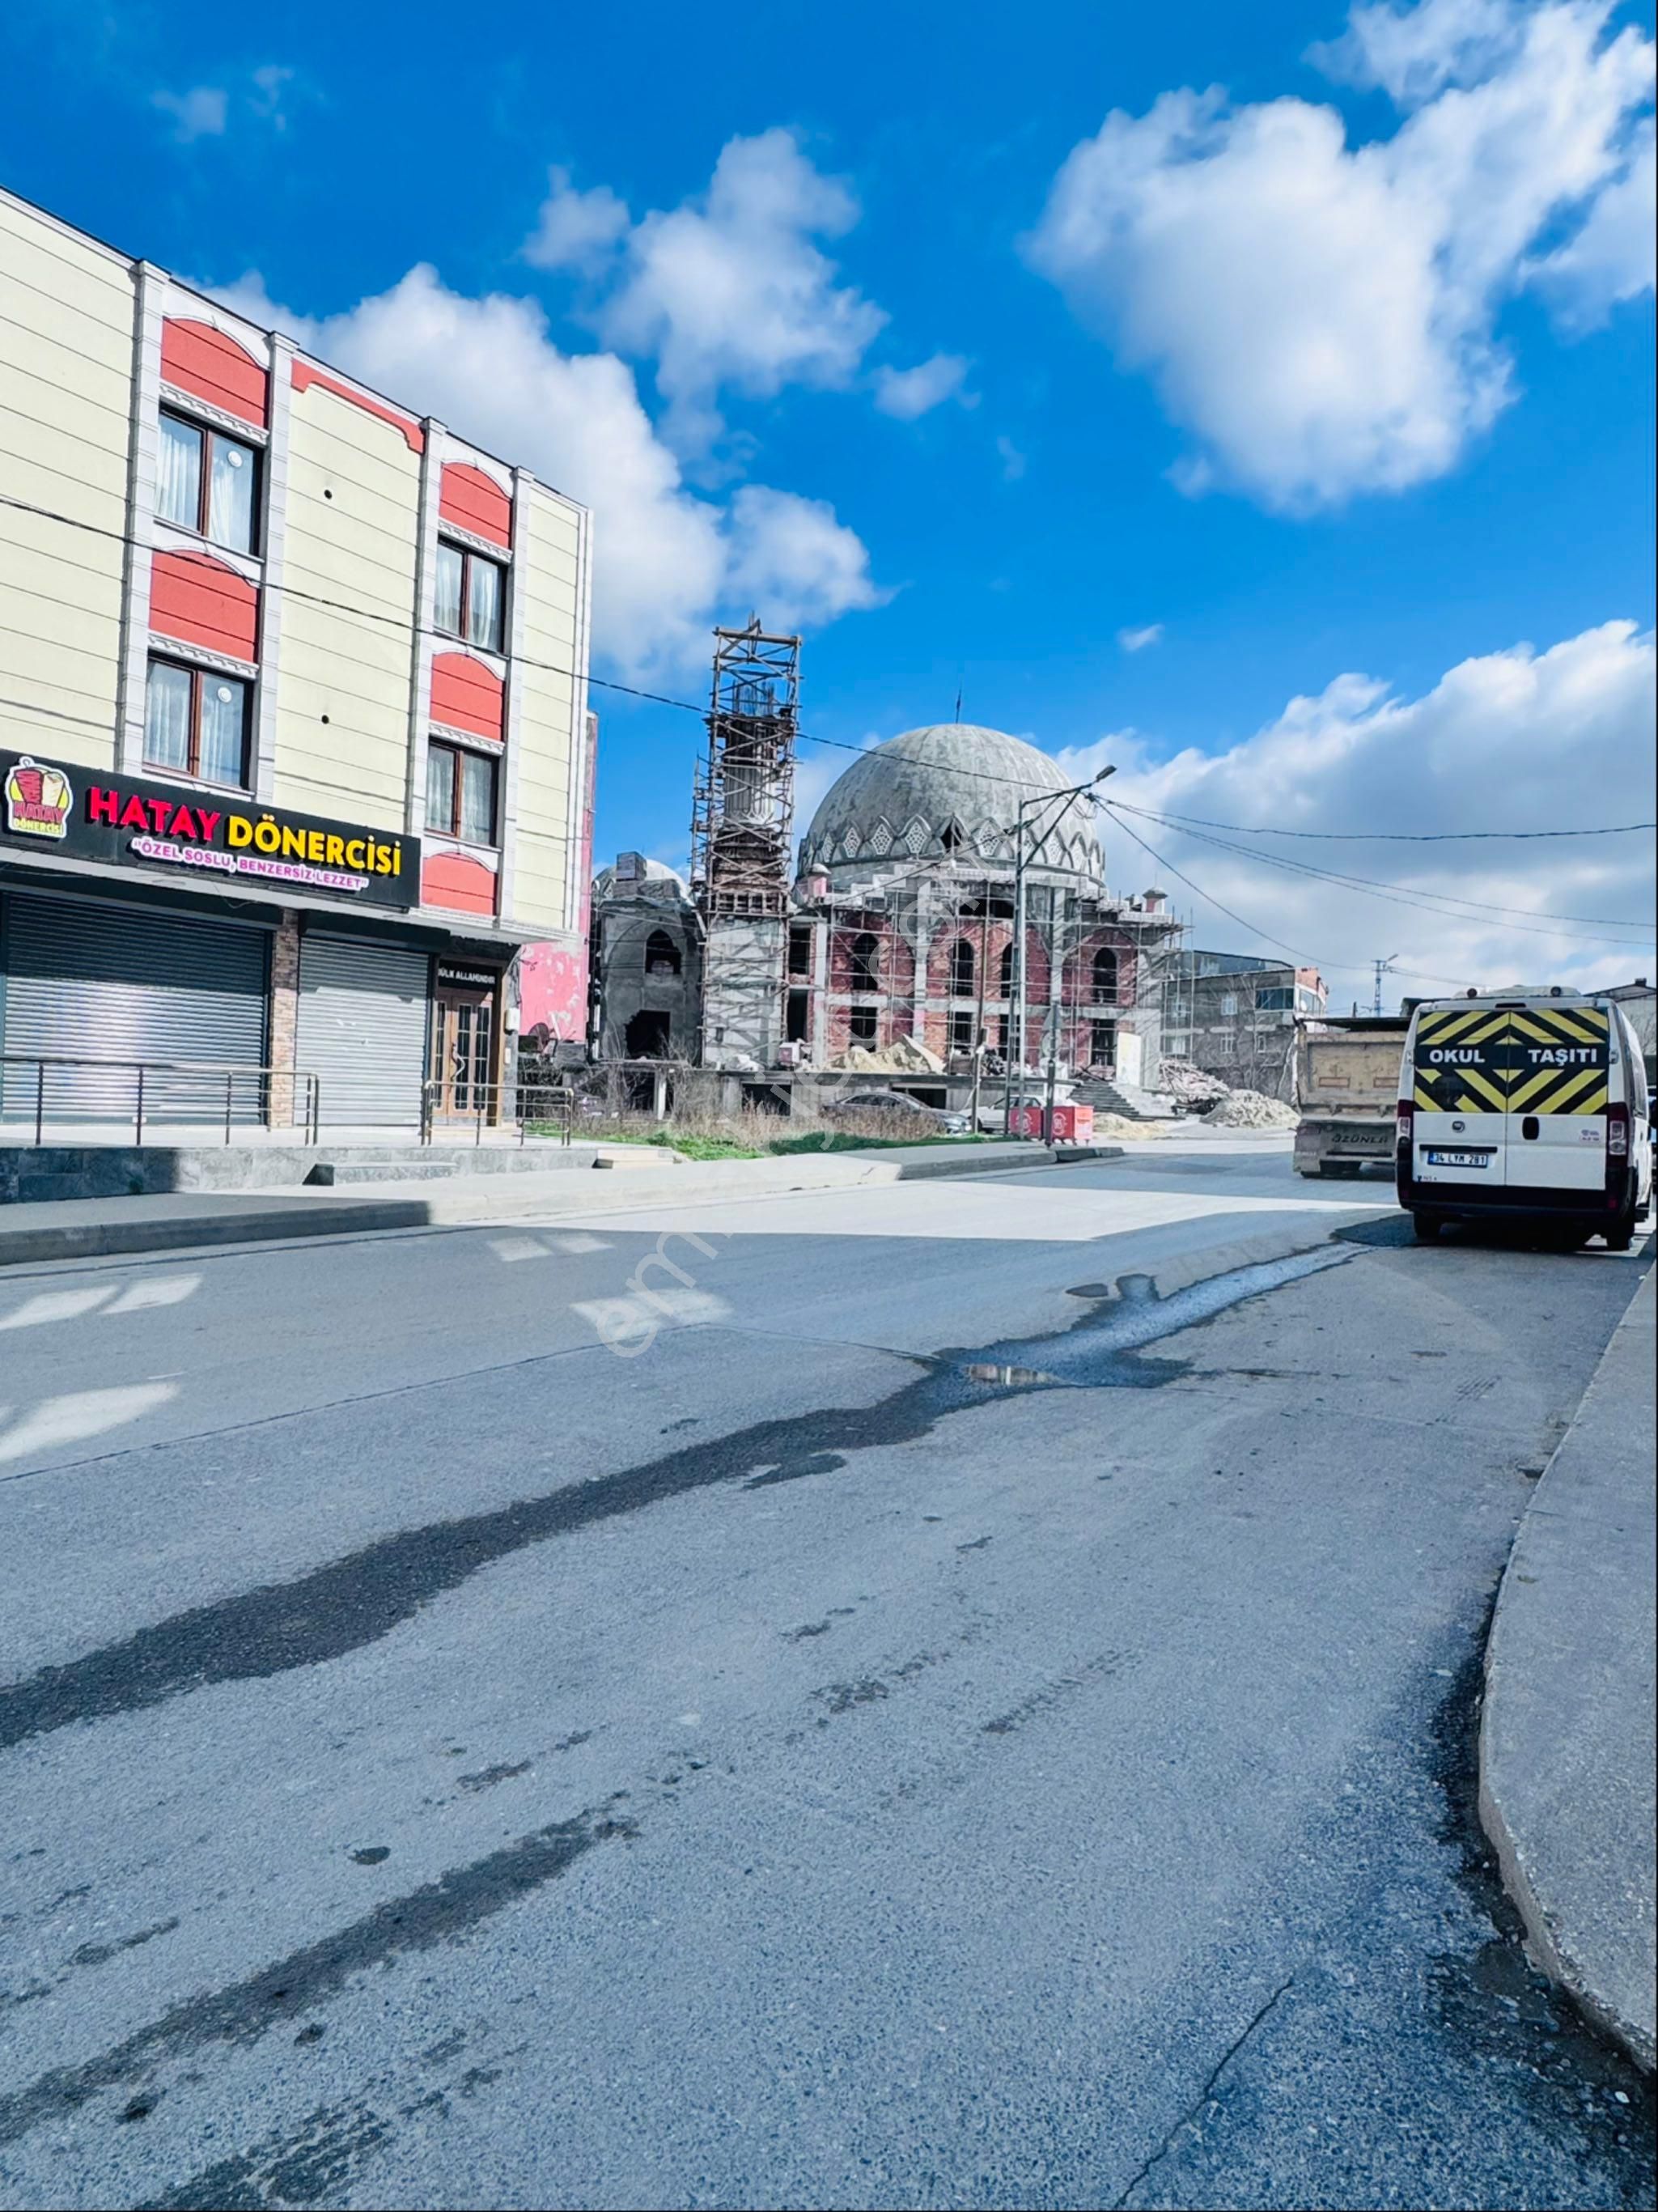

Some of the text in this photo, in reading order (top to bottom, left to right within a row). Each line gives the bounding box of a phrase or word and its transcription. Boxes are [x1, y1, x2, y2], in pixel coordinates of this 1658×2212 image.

[14, 801, 64, 823] HATAY
[89, 787, 401, 875] HATAY DÖNERCİSİ
[184, 847, 236, 872] SOSLU,
[239, 858, 313, 881] BENZERSİZ
[1429, 1048, 1597, 1068] OKUL TAŞITI
